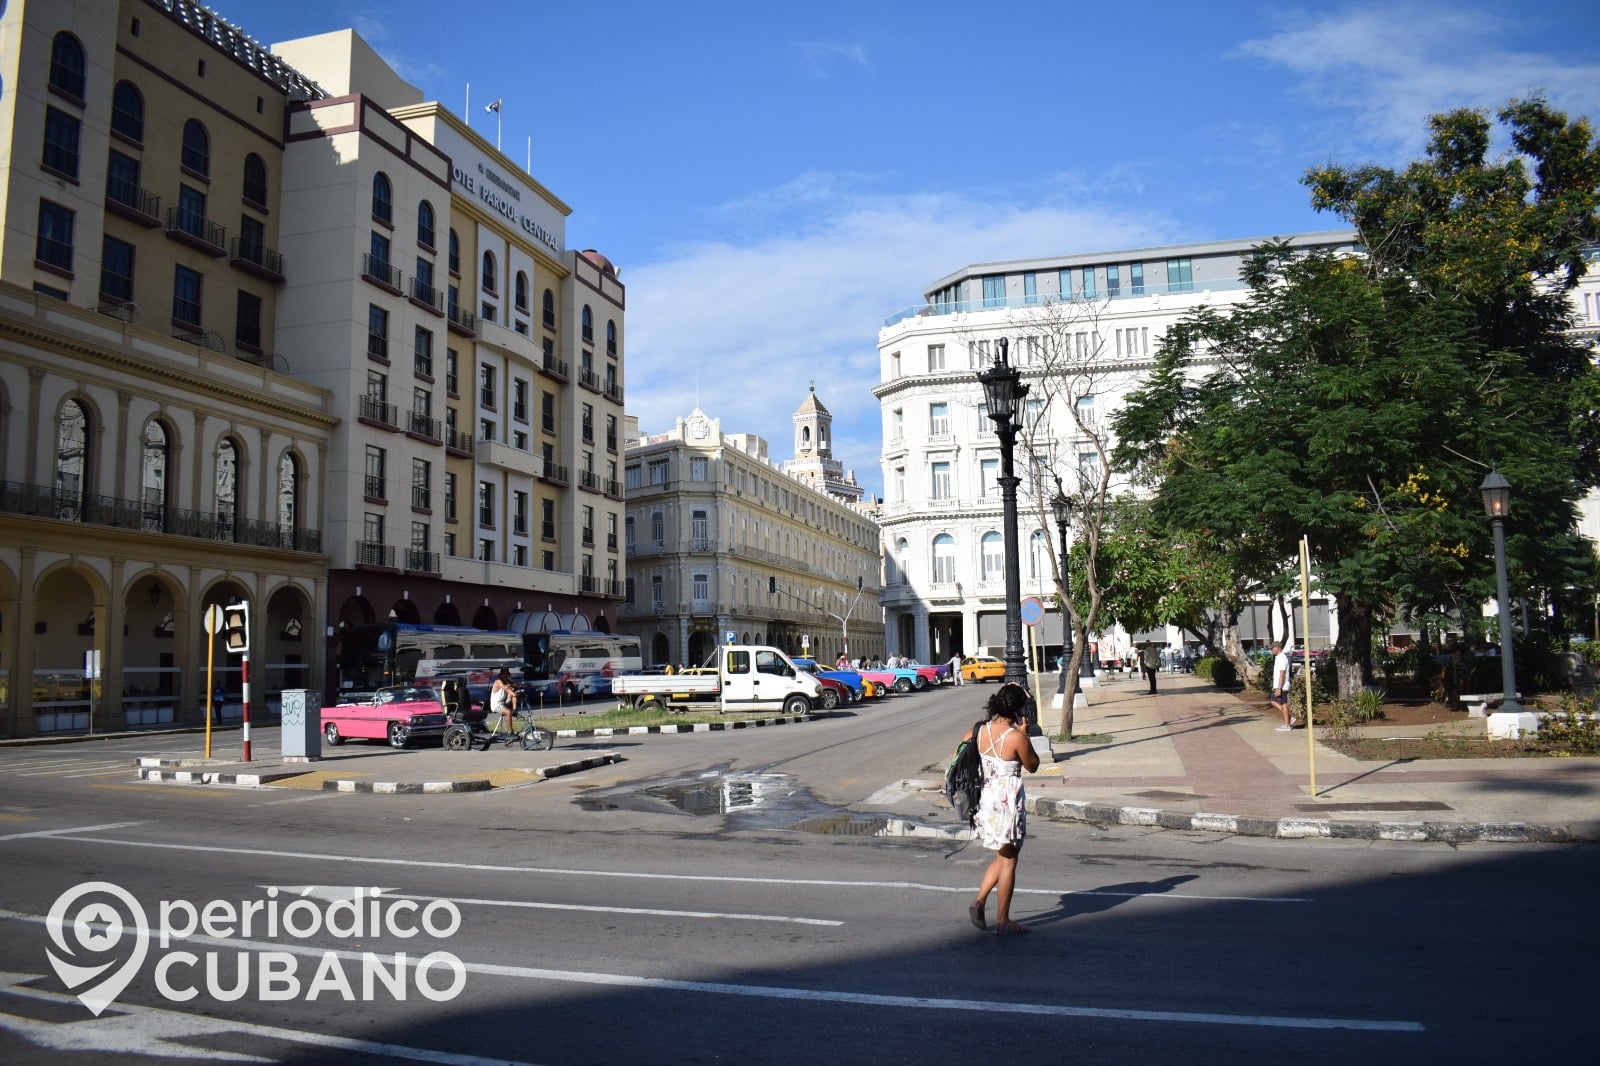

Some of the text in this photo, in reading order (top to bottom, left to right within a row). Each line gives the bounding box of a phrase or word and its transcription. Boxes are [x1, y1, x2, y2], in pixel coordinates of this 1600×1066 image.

[452, 166, 475, 194] OTEL
[480, 185, 518, 223] PARQUE
[521, 215, 560, 252] CENTRAL
